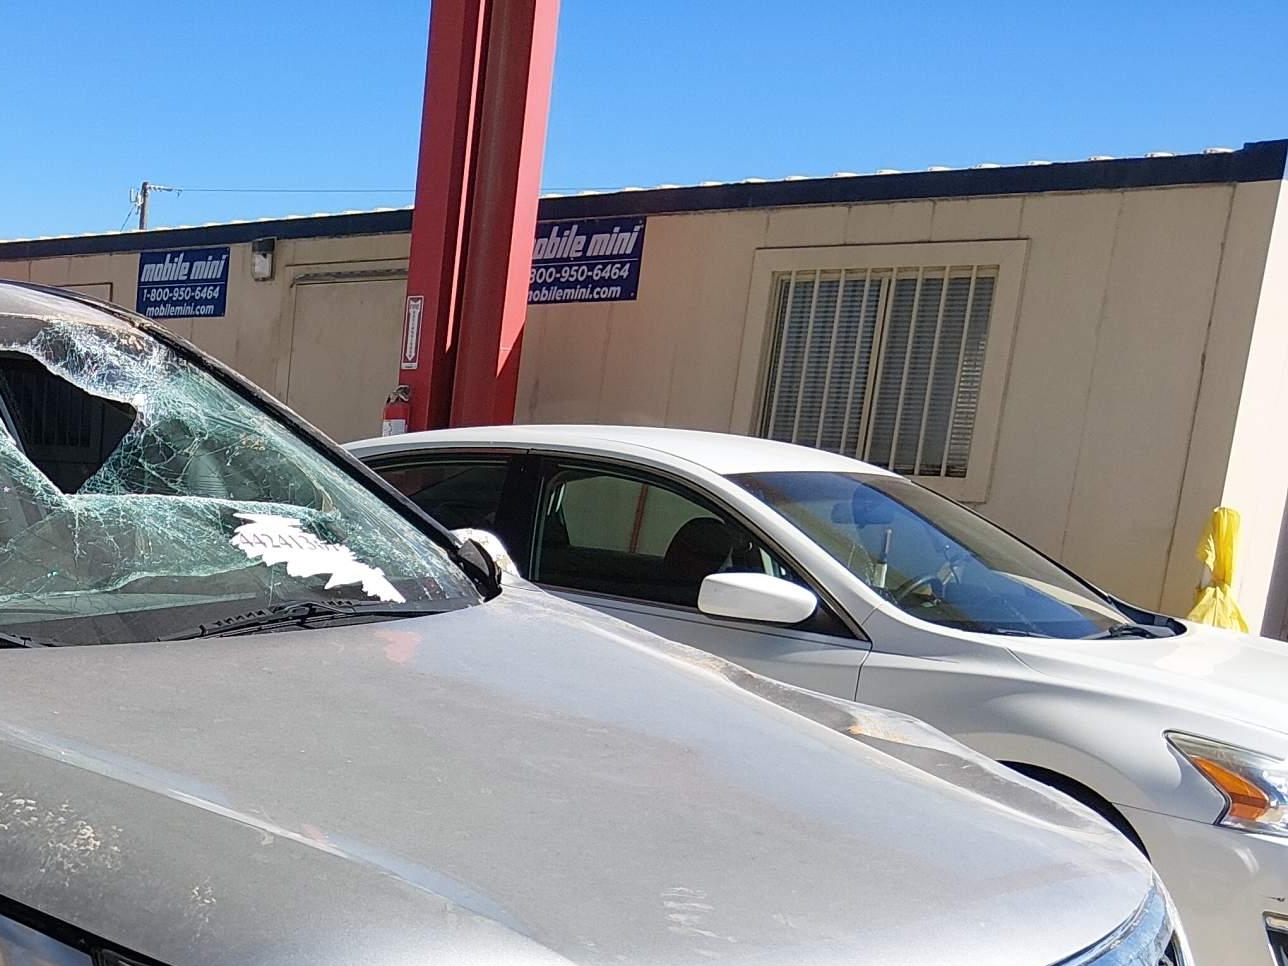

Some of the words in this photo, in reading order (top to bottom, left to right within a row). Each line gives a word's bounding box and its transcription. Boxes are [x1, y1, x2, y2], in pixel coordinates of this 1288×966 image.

[532, 224, 587, 260] obile
[586, 226, 639, 257] mini
[140, 252, 190, 282] mobile
[189, 254, 227, 280] mini
[142, 286, 220, 302] 1-800-950-6464
[145, 302, 215, 317] mobilemini.com
